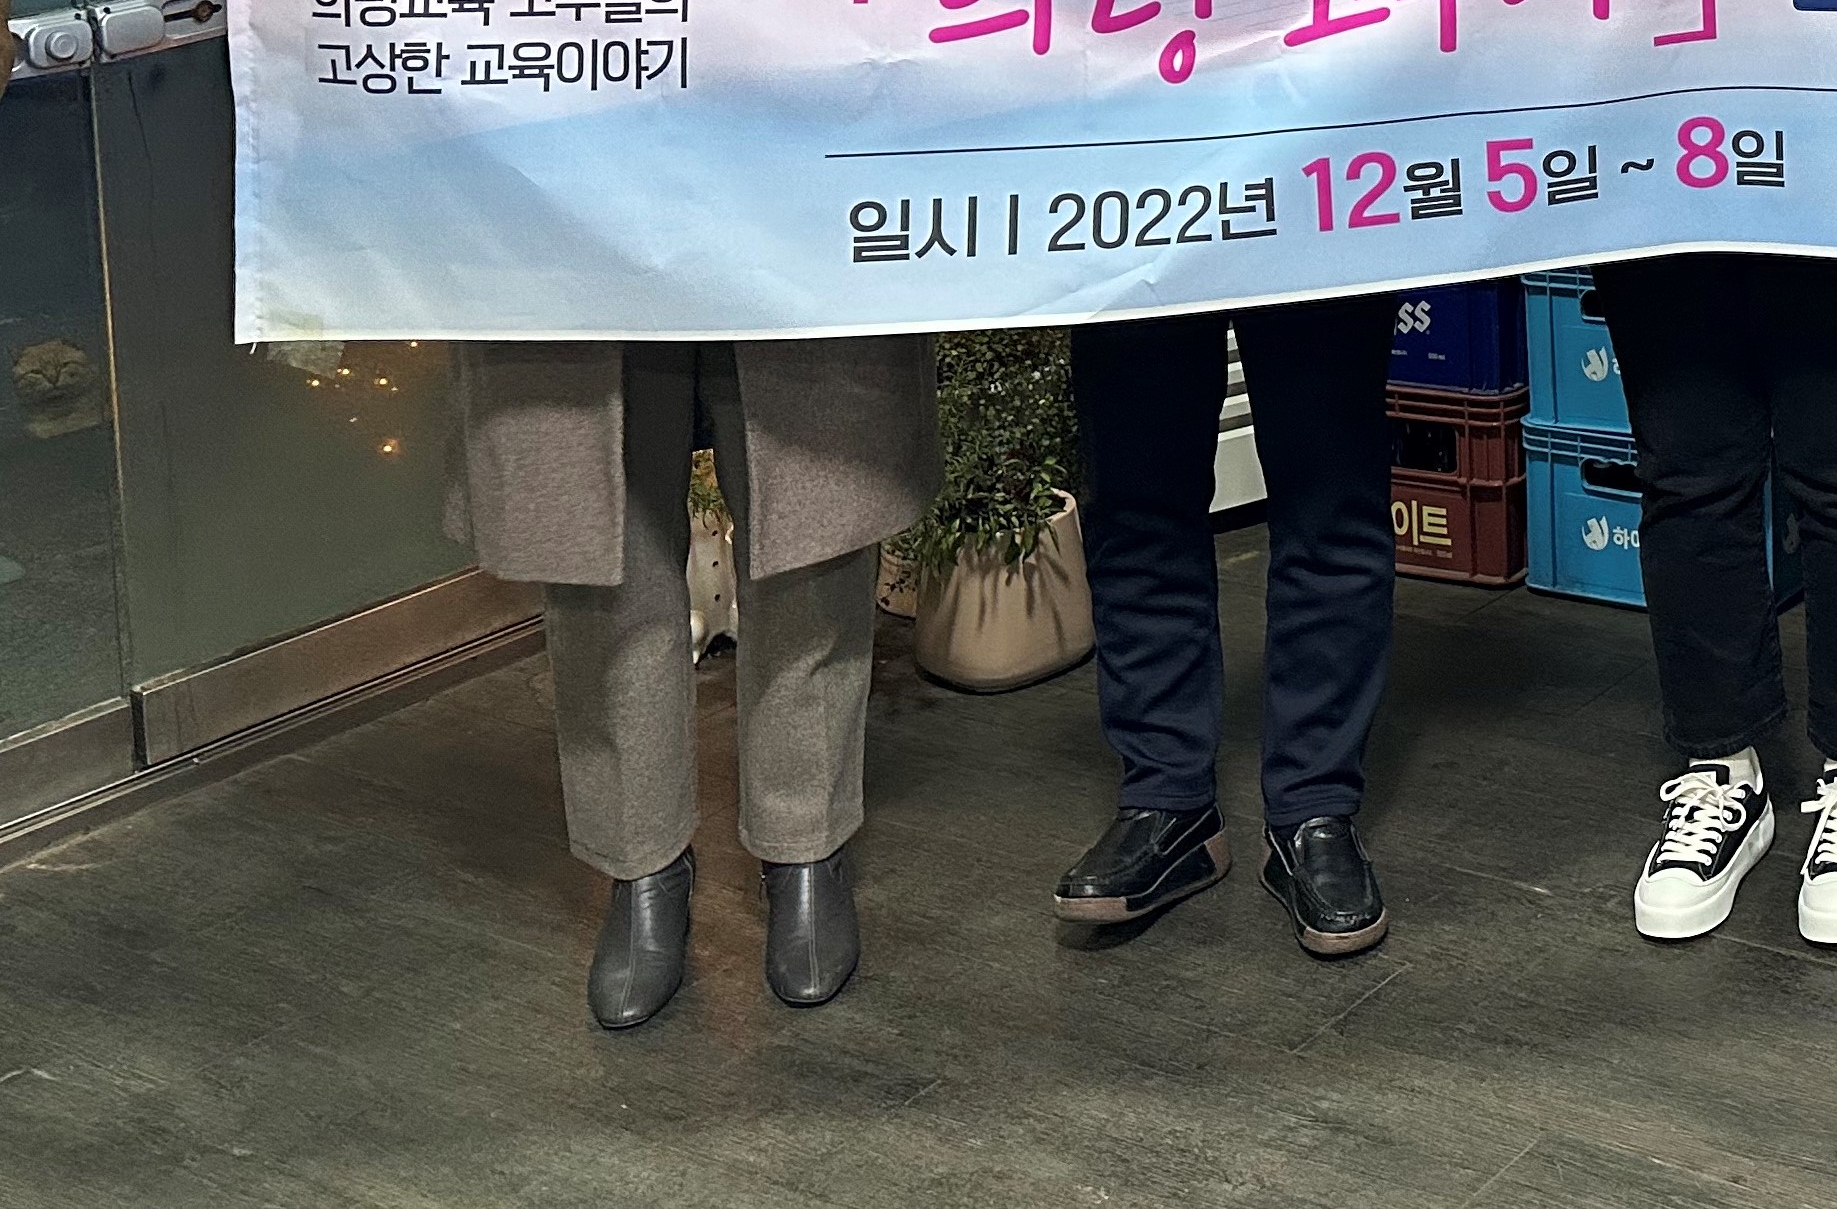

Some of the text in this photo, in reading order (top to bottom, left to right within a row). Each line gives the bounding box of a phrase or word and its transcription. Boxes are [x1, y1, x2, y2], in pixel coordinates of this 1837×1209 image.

[316, 35, 689, 96] 고상한 교육이야기
[848, 194, 979, 264] 일시
[1046, 176, 1279, 253] 2022년
[1302, 151, 1464, 233] 12월
[1485, 137, 1600, 214] 5일
[1675, 115, 1786, 190] 8일
[1393, 299, 1432, 336] SS
